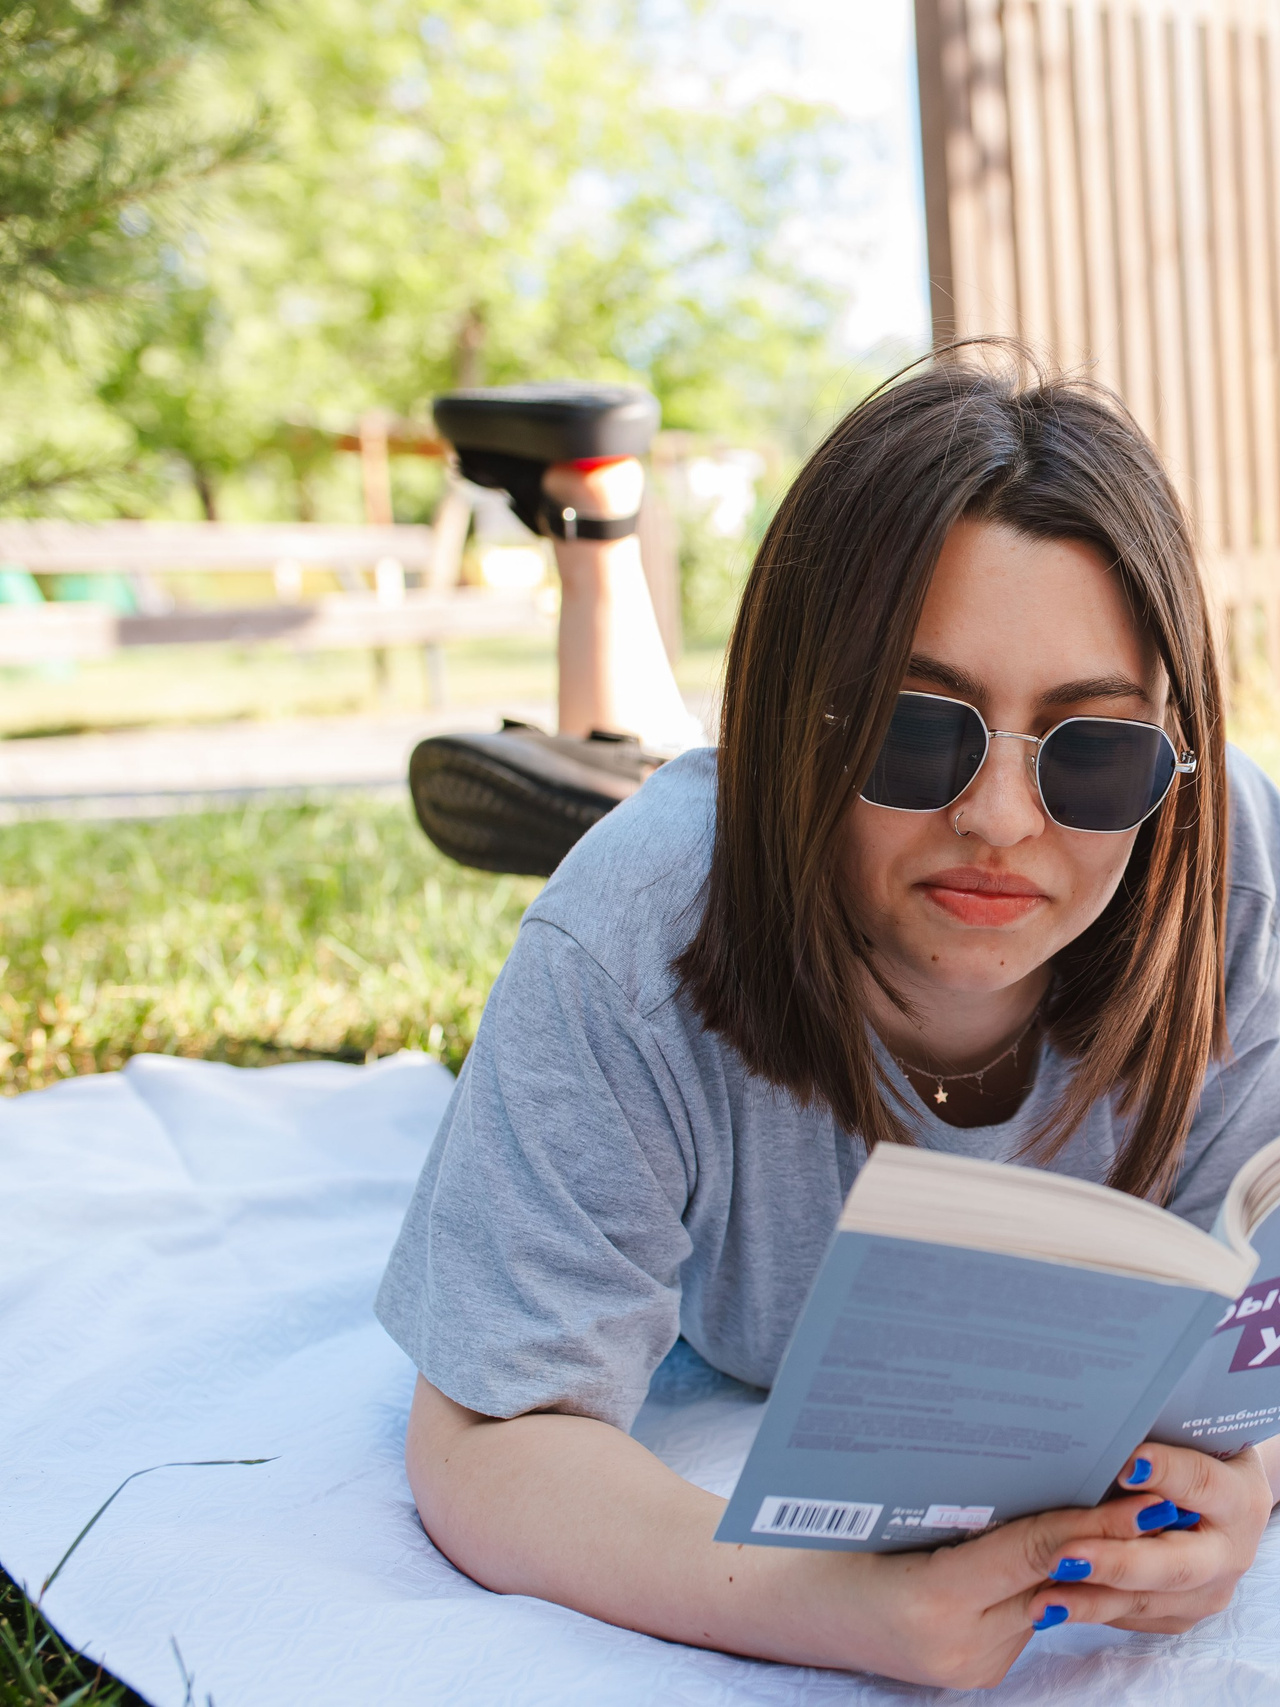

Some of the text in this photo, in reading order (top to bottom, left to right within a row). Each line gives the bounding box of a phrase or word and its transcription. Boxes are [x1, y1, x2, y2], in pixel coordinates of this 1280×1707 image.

[1182, 1417, 1213, 1430] как
[1192, 1429, 1203, 1438] и
[1207, 1417, 1274, 1435] помнить
